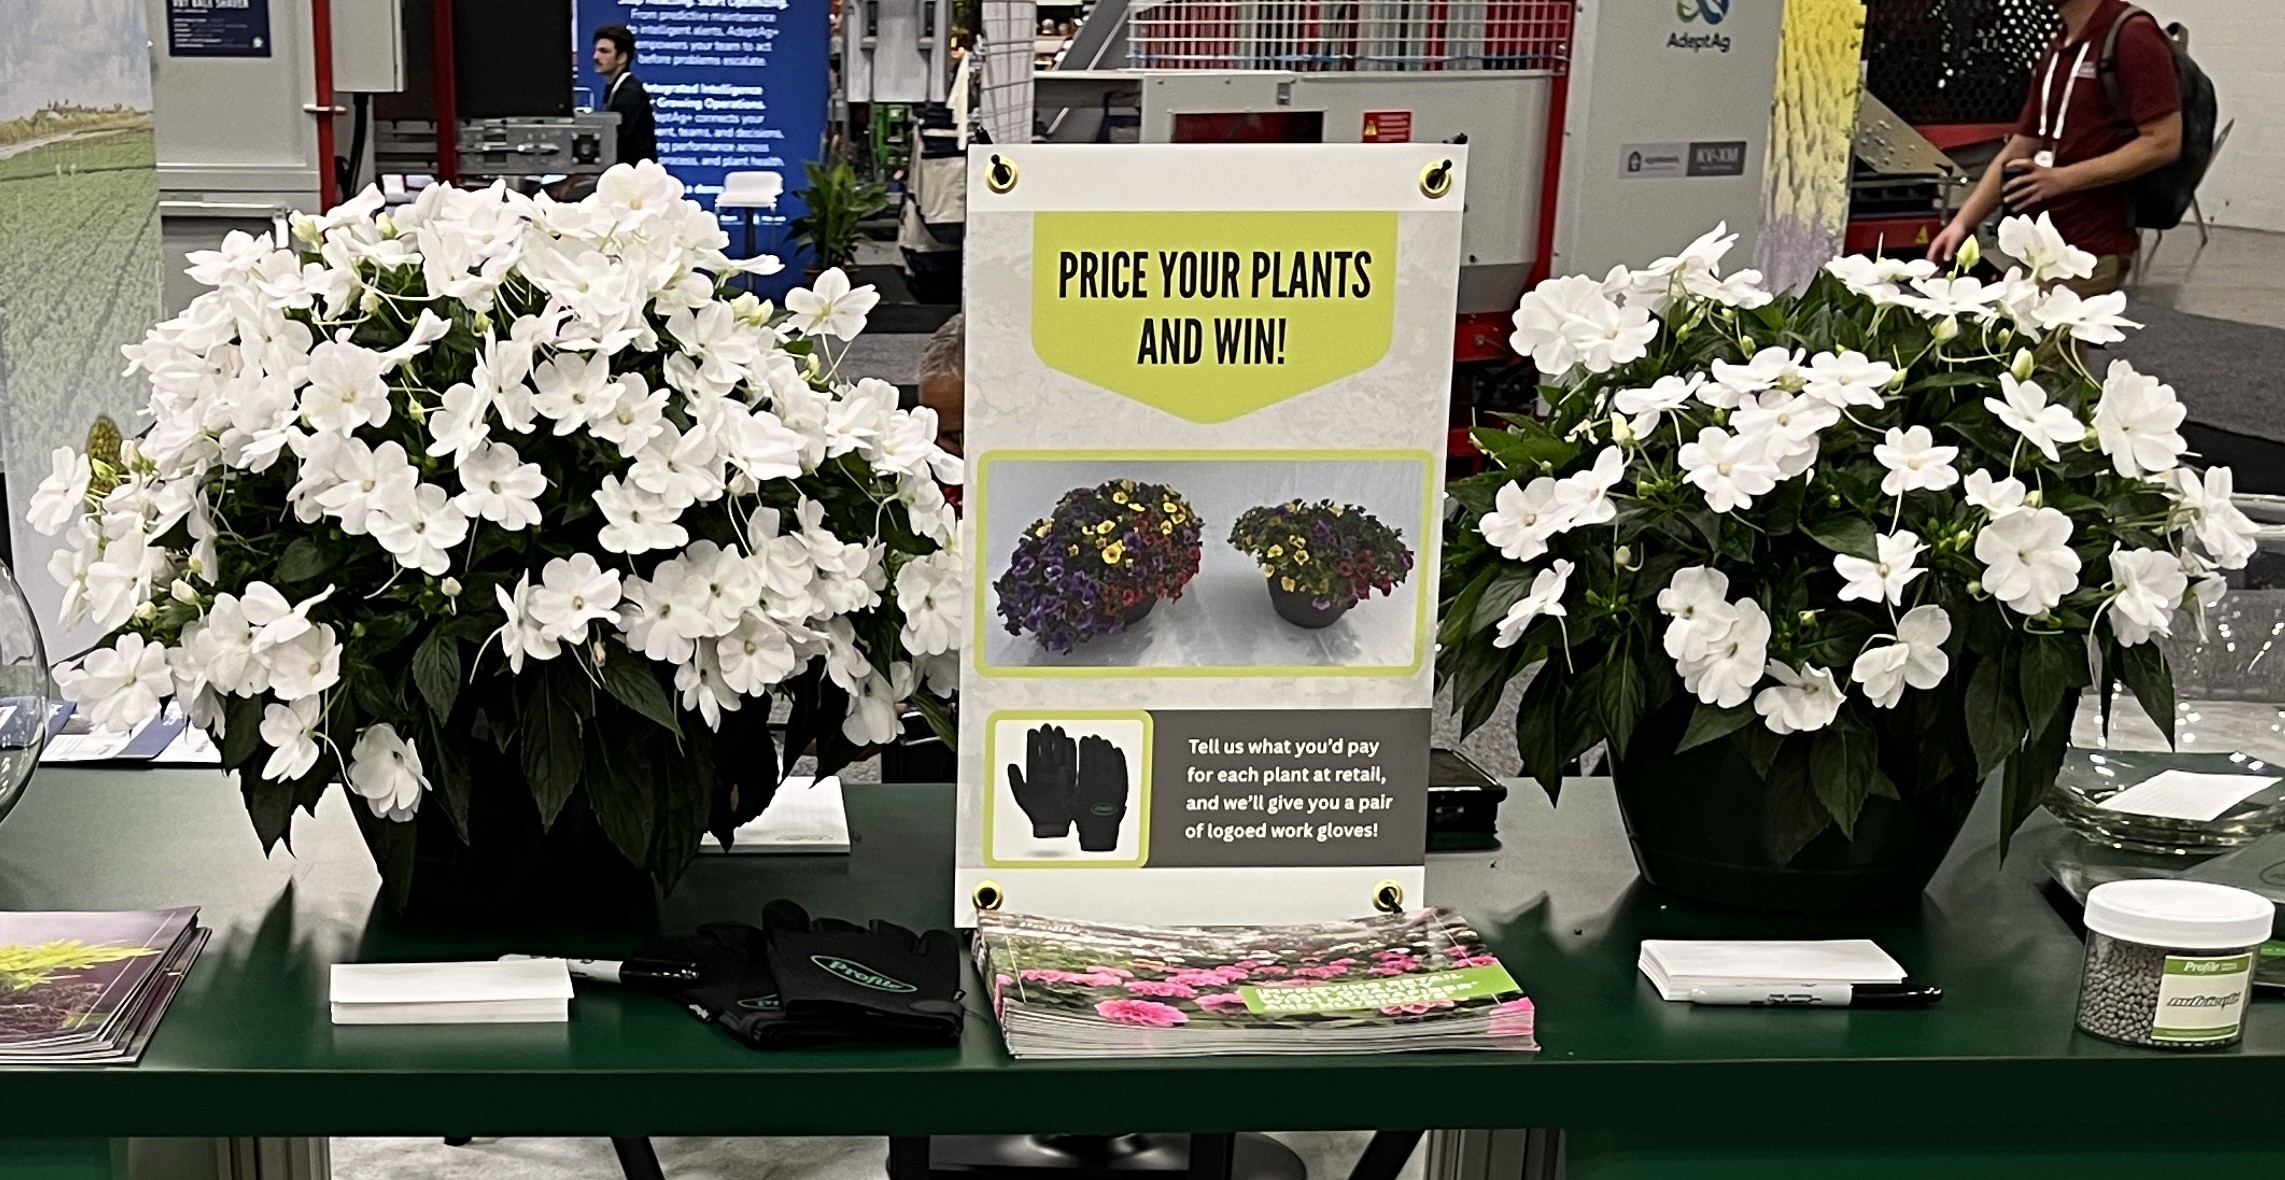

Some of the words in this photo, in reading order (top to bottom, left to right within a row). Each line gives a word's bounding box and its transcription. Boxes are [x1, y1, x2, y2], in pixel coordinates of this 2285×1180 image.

[630, 8, 657, 20] From
[659, 9, 709, 21] predictive
[710, 10, 776, 22] maintenance
[640, 24, 692, 37] intelligent
[693, 25, 726, 36] alerts.
[726, 26, 779, 39] AdeptAg+
[634, 41, 688, 51] empowers
[690, 42, 713, 52] your
[714, 41, 741, 51] team
[742, 41, 754, 51] to
[755, 42, 772, 51] act
[1666, 32, 1731, 54] AdeptAg
[637, 54, 671, 64] before
[672, 55, 721, 66] problems
[722, 55, 767, 66] escalate.
[700, 83, 763, 97] Intelligence
[656, 96, 703, 110] Growing
[704, 97, 766, 111] Operations.
[695, 114, 740, 124] connects
[741, 115, 765, 125] your
[678, 128, 712, 138] teams,
[714, 128, 734, 138] and
[735, 128, 785, 139] decisions,
[671, 141, 735, 152] performance
[736, 143, 770, 152] across
[701, 156, 721, 166] and
[722, 156, 749, 167] plant
[1058, 250, 1148, 300] PRICE
[1159, 250, 1240, 300] YOUR
[1251, 250, 1373, 300] PLANTS
[1137, 317, 1203, 365] AND
[1214, 317, 1287, 365] WIN!
[1188, 738, 1221, 755] Tell
[1223, 741, 1245, 755] us
[1248, 737, 1292, 755] what
[1294, 737, 1344, 759] you'd
[1347, 741, 1380, 758] pay
[1187, 766, 1214, 783] for
[1217, 766, 1259, 783] each
[1263, 766, 1310, 786] plant
[1312, 767, 1332, 783] at
[1335, 765, 1387, 785] retail,
[1185, 794, 1220, 811] and
[1223, 794, 1265, 811] we'll
[1267, 794, 1304, 815] give
[1306, 797, 1340, 815] you
[1344, 797, 1355, 811] a
[1358, 793, 1394, 814] pair
[1185, 822, 1205, 839] of
[1207, 822, 1267, 843] logoed
[1271, 822, 1314, 839] work
[1316, 822, 1379, 843] gloves!
[2183, 961, 2220, 974] Profile
[829, 961, 903, 990] Profile
[1385, 973, 1464, 986] RETAIL
